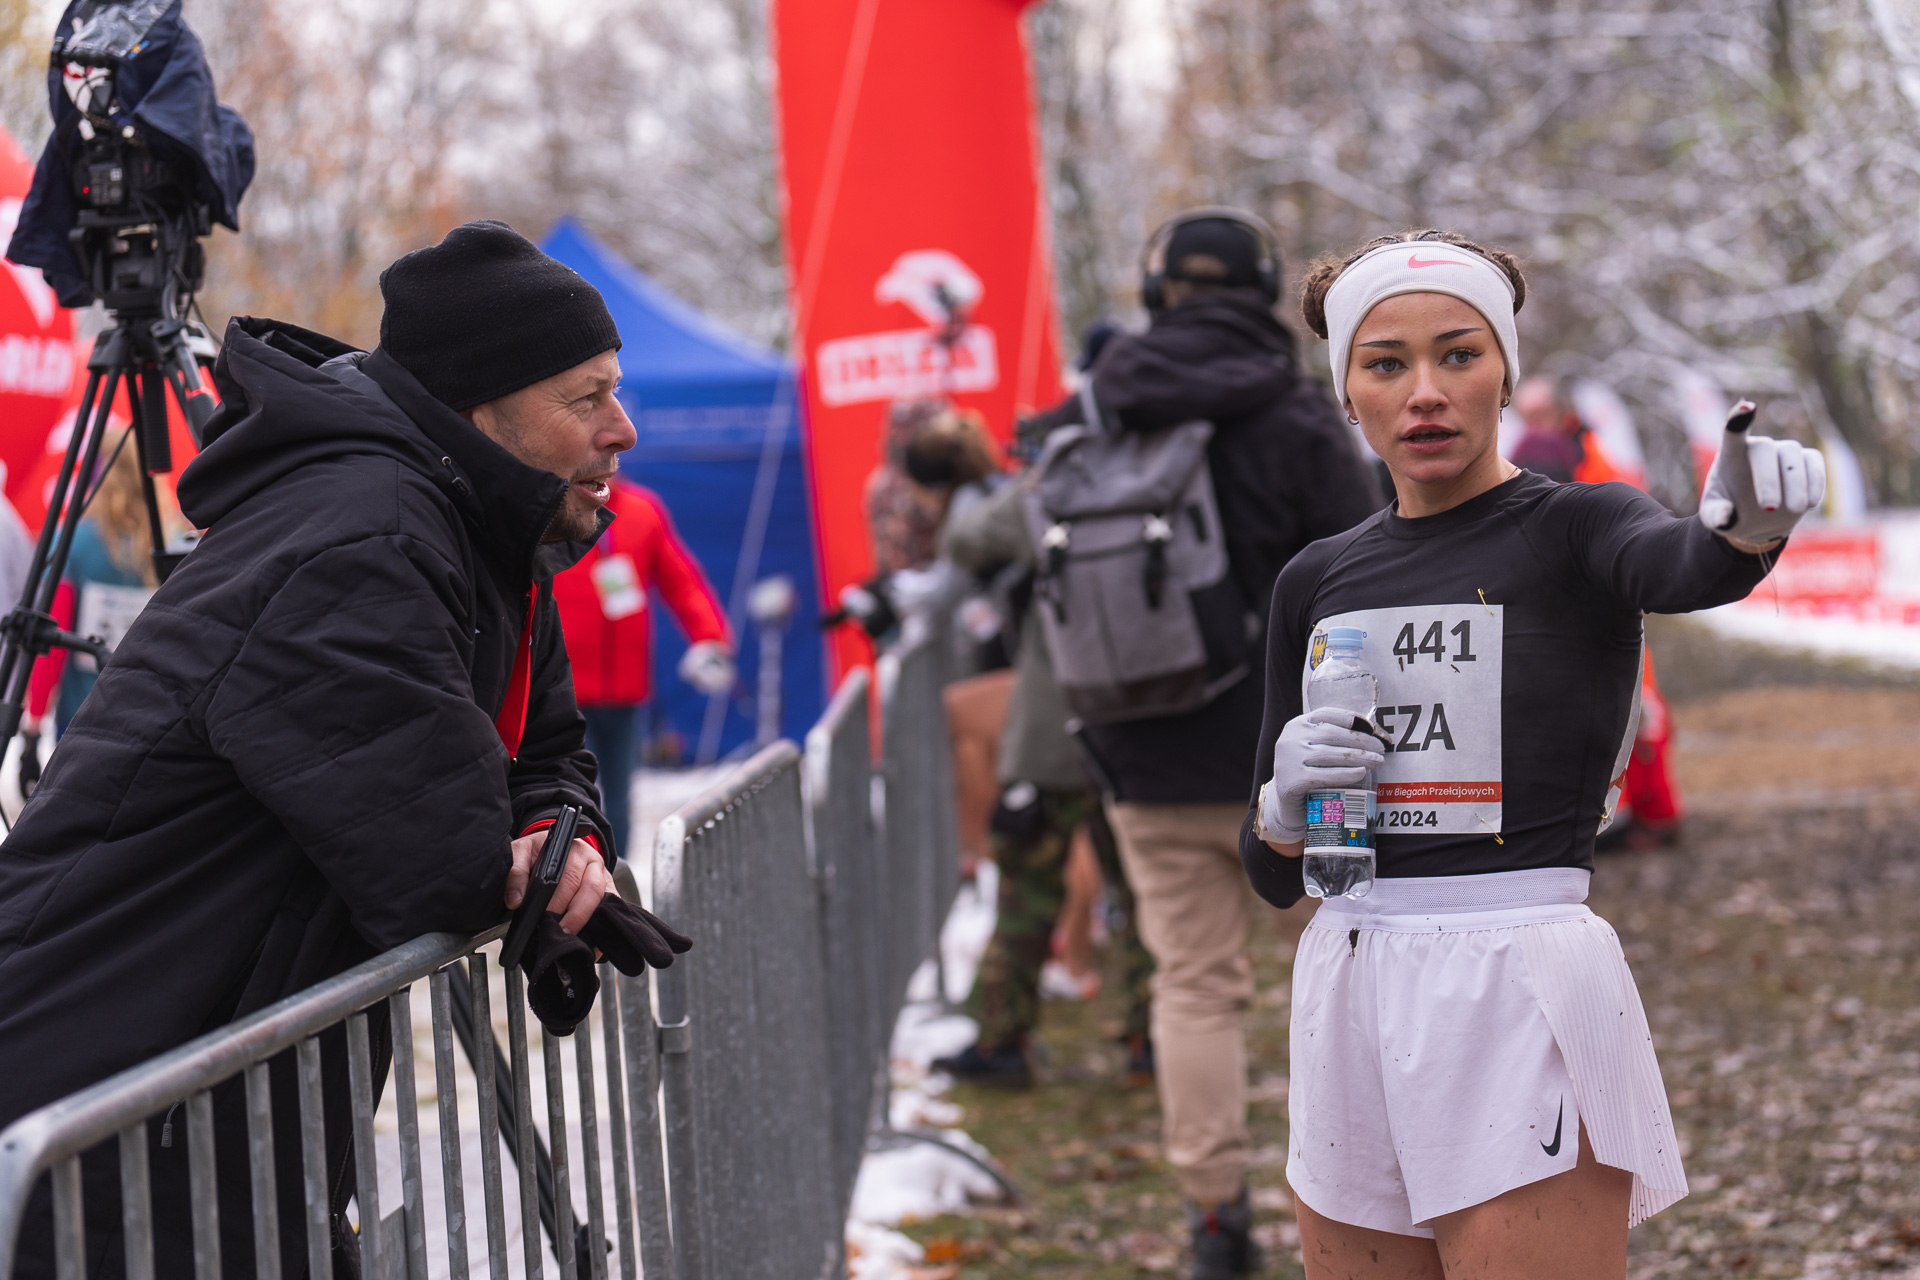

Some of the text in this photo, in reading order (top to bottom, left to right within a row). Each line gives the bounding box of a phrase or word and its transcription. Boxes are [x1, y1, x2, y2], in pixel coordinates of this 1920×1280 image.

[1392, 620, 1477, 665] 441
[1386, 788, 1394, 797] w
[1394, 786, 1428, 799] Biegach
[1429, 786, 1495, 798] Przełajowych
[1389, 810, 1438, 828] 2024
